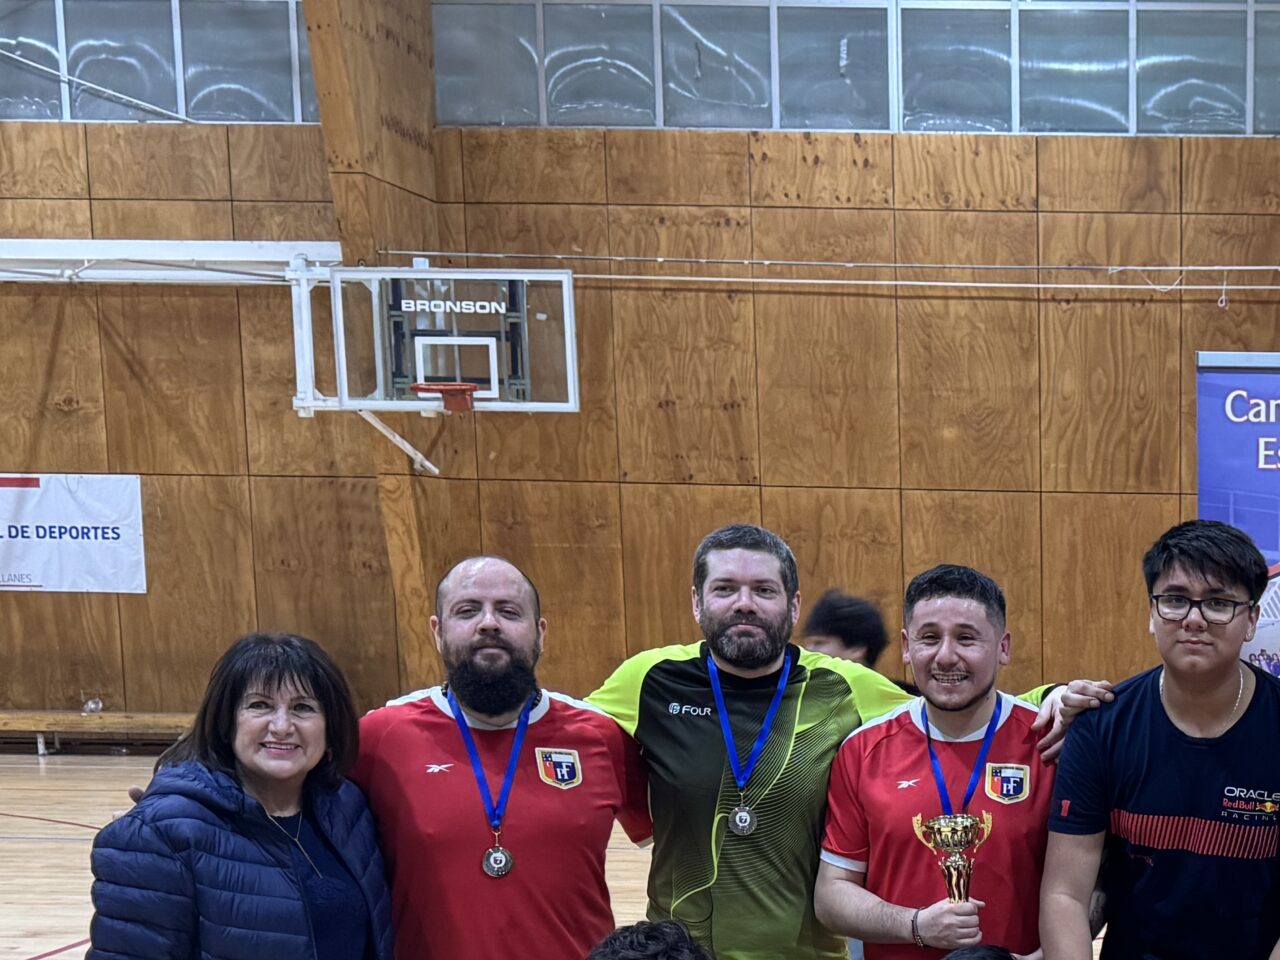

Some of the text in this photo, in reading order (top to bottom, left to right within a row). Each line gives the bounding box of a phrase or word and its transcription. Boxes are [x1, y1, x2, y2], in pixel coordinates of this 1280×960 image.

[401, 299, 506, 314] BRONSON
[8, 525, 30, 539] DE
[35, 525, 121, 540] DEPORTES
[1, 573, 32, 584] LANES
[681, 704, 712, 717] FOUR
[1222, 797, 1255, 811] Red Bull
